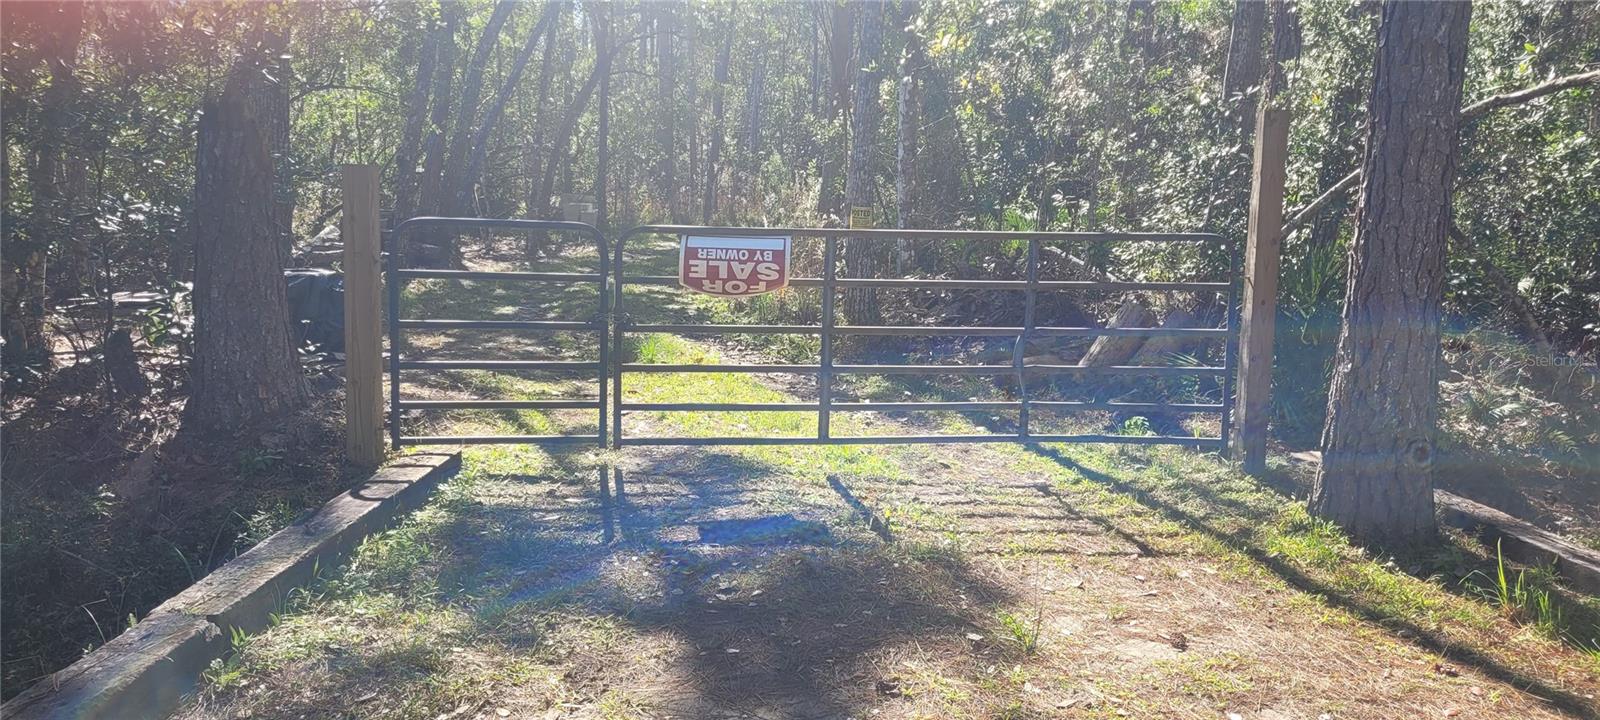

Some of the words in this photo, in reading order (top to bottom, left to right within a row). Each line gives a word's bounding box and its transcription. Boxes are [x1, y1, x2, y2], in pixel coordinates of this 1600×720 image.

[698, 249, 749, 261] OWNER
[754, 251, 773, 261] BY
[689, 260, 780, 280] SALE
[702, 280, 766, 293] FOR
